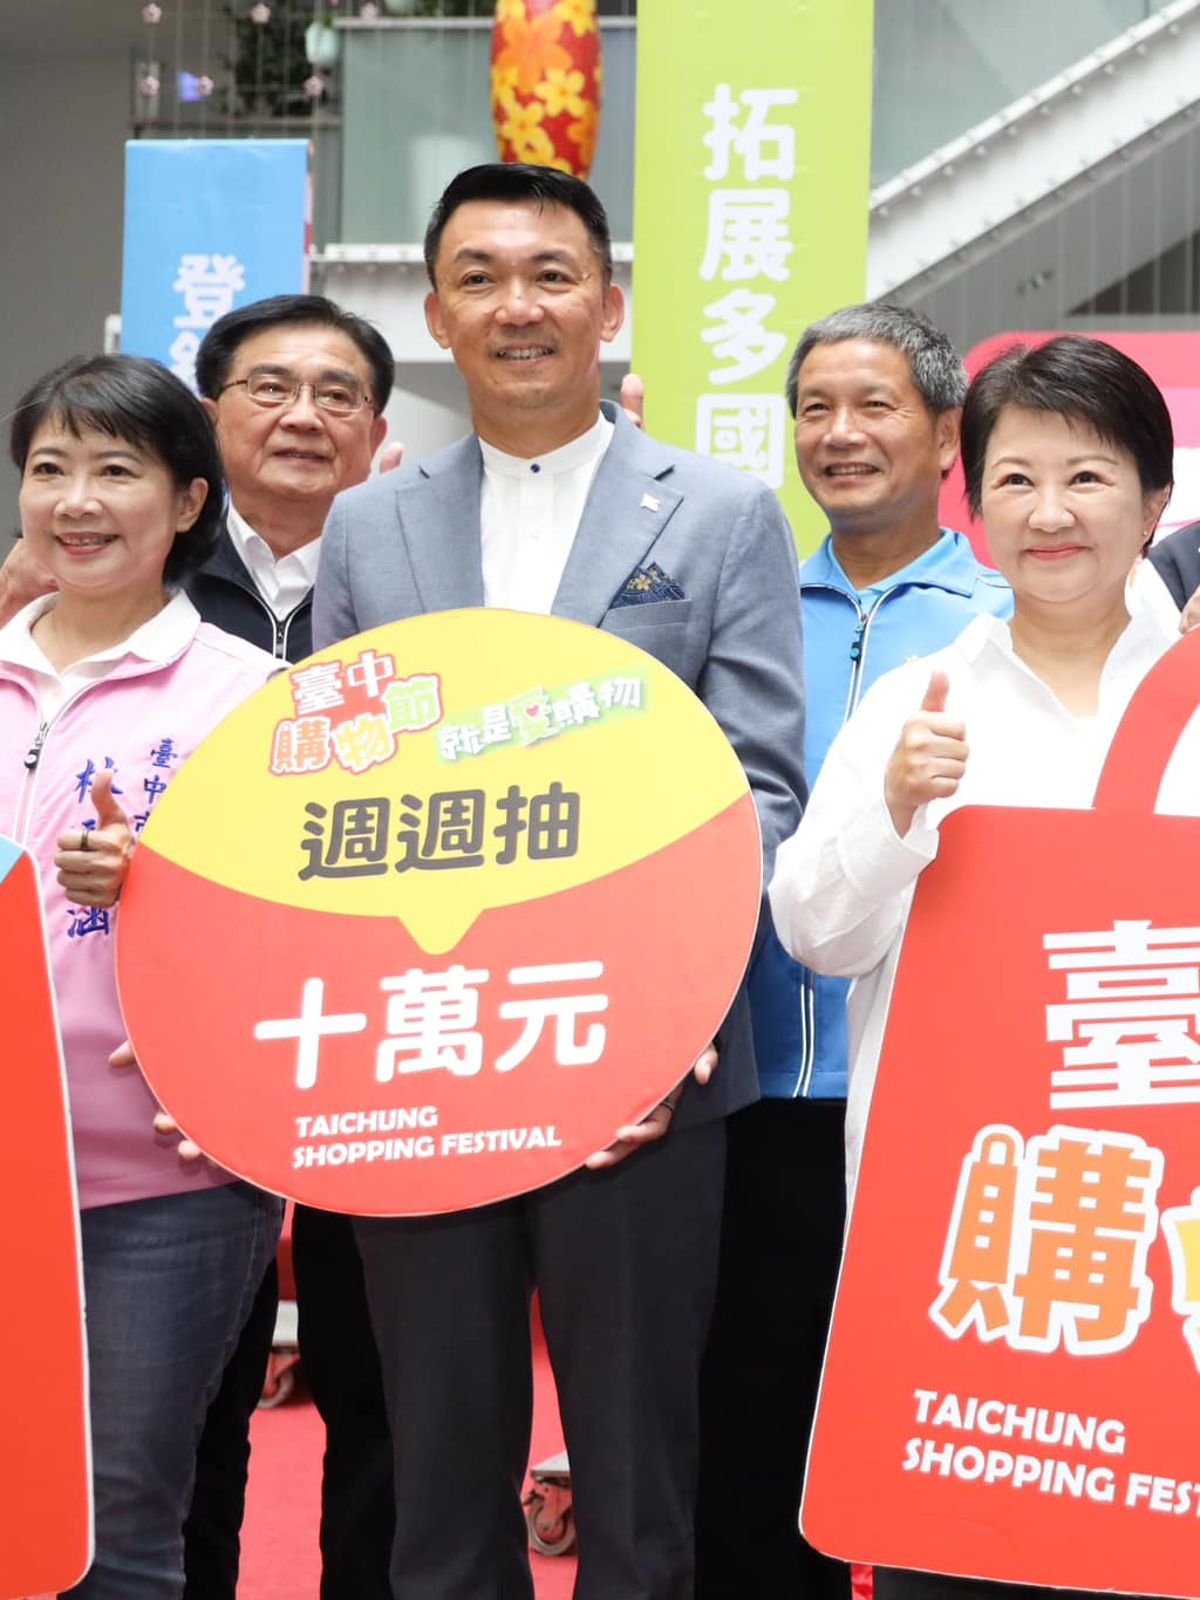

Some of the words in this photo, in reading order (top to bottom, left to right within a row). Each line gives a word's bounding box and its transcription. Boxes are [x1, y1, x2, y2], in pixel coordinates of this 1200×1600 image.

[695, 84, 799, 489] 拓展多國
[291, 651, 394, 715] 臺中
[437, 677, 643, 760] 就是愛購物
[271, 674, 443, 774] 購物節
[300, 781, 580, 882] 週週抽
[253, 960, 609, 1090] 十萬元
[292, 1138, 436, 1169] SHOPPING
[441, 1125, 562, 1157] FESTIVAL
[295, 1106, 438, 1138] TAICHUNG
[913, 1389, 1126, 1454] TAICHUNG
[902, 1438, 1115, 1502] SHOPPING
